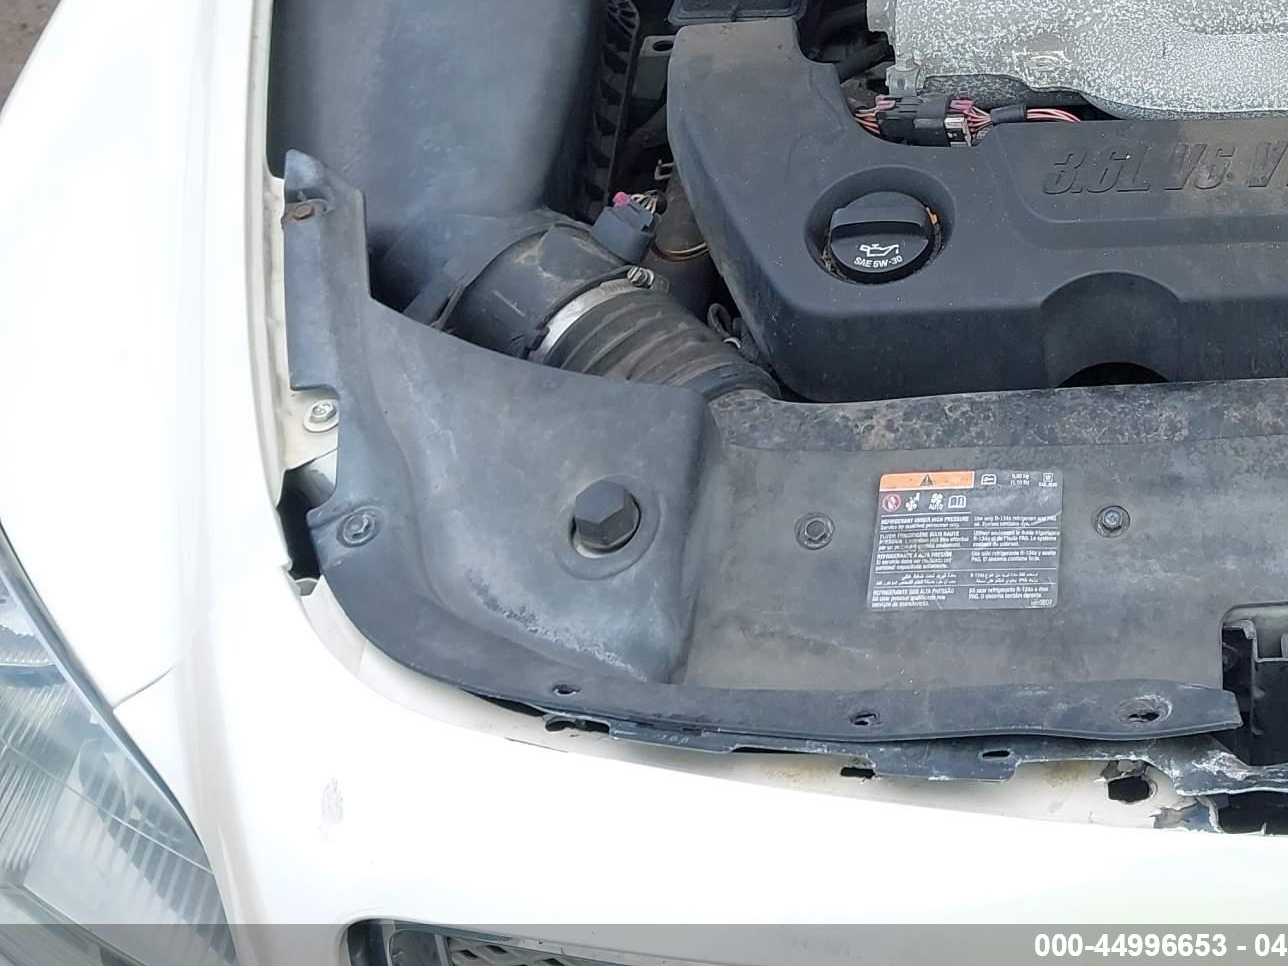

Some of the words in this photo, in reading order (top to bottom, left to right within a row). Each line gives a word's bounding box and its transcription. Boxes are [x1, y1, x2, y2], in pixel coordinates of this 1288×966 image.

[1043, 145, 1150, 194] 3.6L
[1165, 143, 1235, 190] V6
[854, 256, 872, 268] SAE
[873, 255, 903, 268] 5W-30
